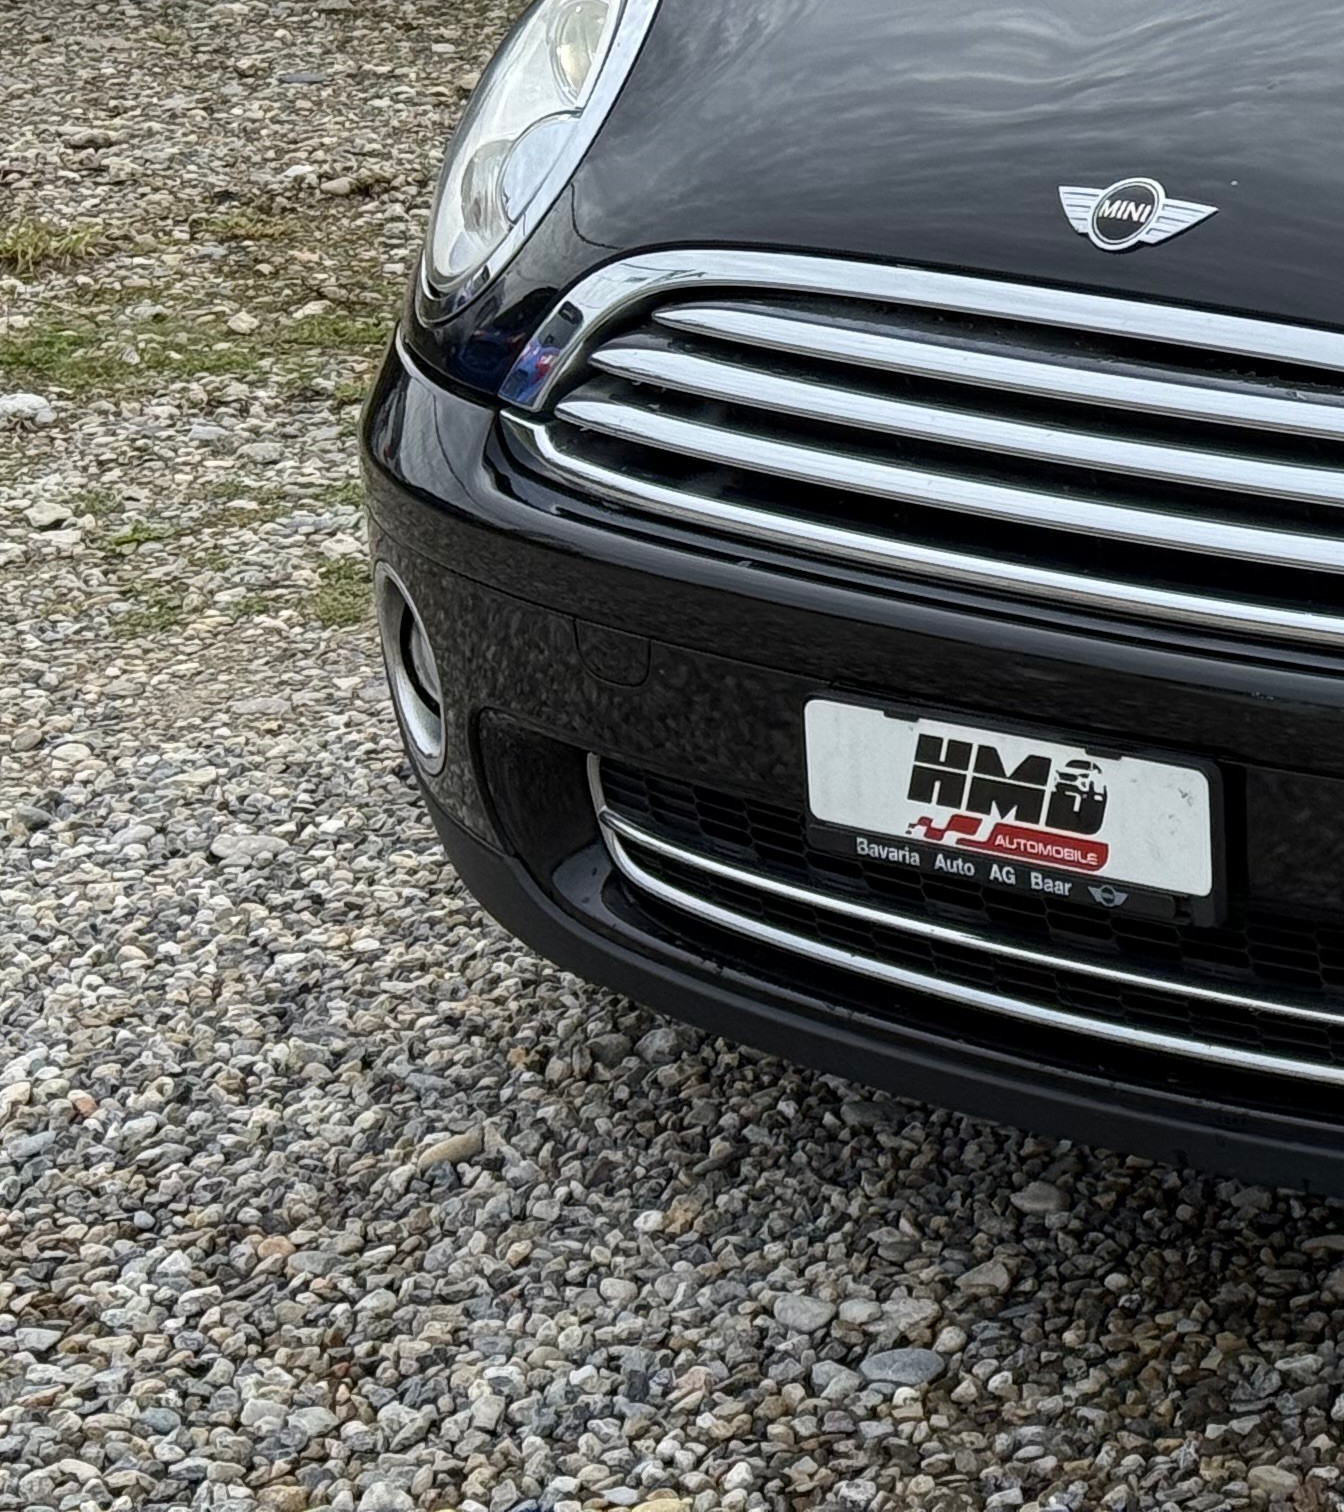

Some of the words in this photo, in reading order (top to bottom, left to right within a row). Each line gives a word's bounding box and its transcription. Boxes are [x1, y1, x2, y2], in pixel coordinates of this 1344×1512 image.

[1099, 200, 1152, 223] MINI
[907, 733, 1109, 835] HMD
[856, 837, 921, 867] Bavaria
[934, 852, 976, 877] Auto
[989, 865, 1017, 886] AG
[1030, 871, 1073, 898] Baar
[994, 832, 1100, 867] AUTOMOBILE
